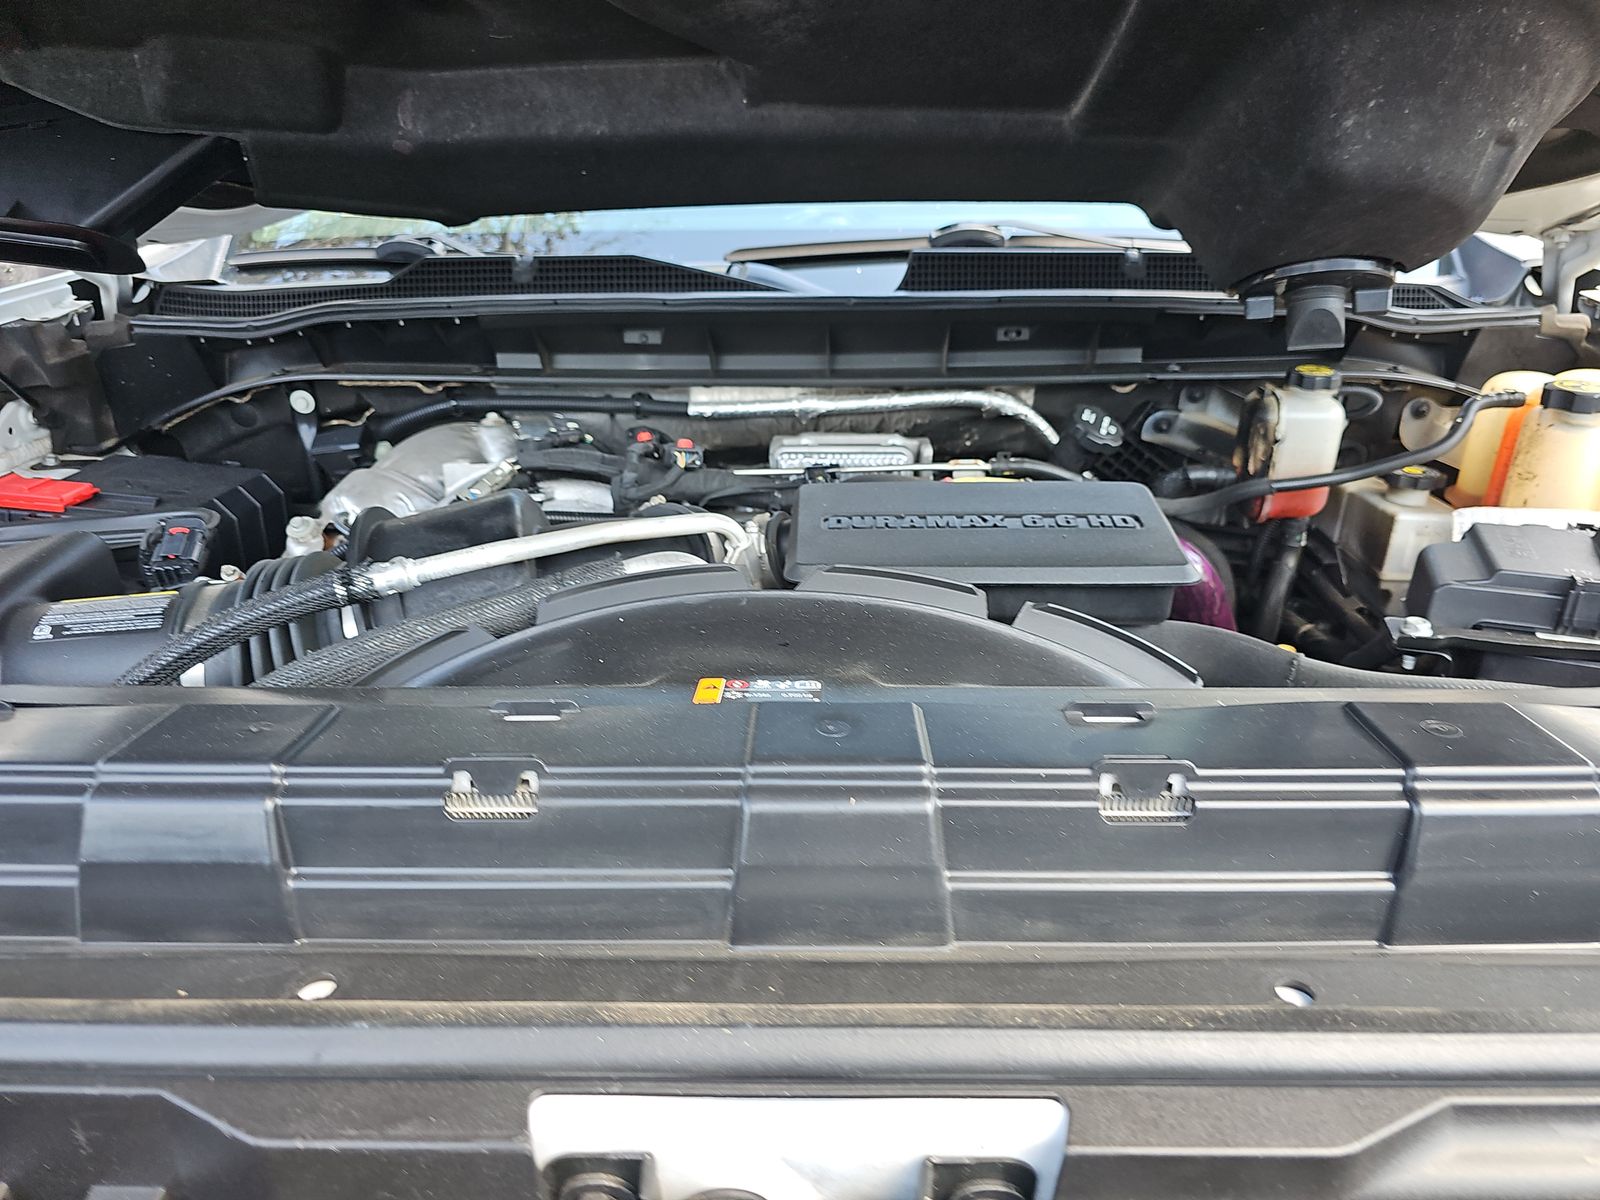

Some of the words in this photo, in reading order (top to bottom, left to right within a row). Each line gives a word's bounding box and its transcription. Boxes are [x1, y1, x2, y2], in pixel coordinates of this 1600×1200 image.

[826, 514, 1006, 529] DURAMAX
[1021, 513, 1079, 529] 6.6
[1086, 513, 1139, 529] HD
